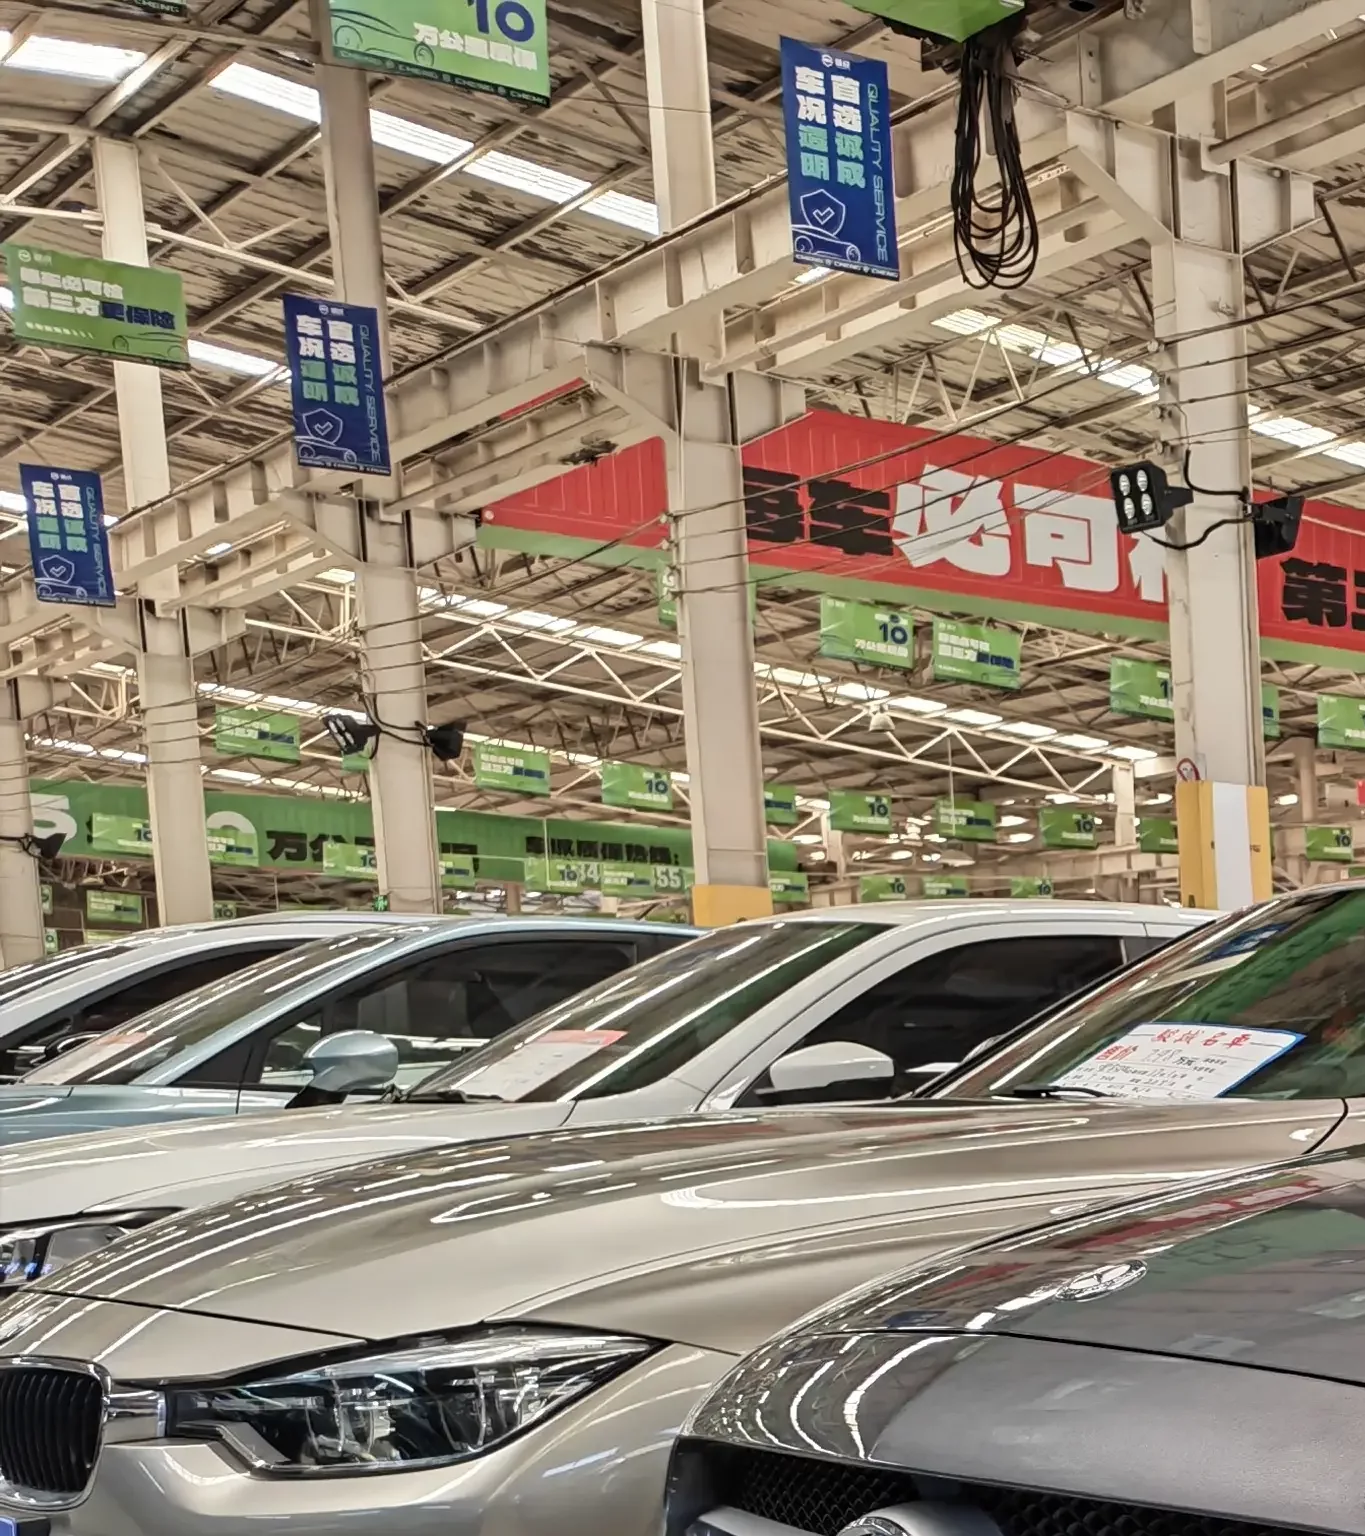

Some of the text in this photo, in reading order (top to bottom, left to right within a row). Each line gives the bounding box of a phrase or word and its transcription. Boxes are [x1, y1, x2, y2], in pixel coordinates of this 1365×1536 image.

[467, 0, 536, 42] 10
[867, 83, 888, 263] QUALITY SERVICE
[359, 324, 382, 464] QUALITY SERVICE
[743, 464, 1168, 604] 每车必可
[878, 622, 909, 645] 10
[1160, 681, 1172, 698] 1
[645, 779, 668, 794] 10
[868, 801, 888, 817] 10
[1075, 818, 1094, 834] 10
[1334, 834, 1351, 847] 10
[890, 882, 905, 895] 10
